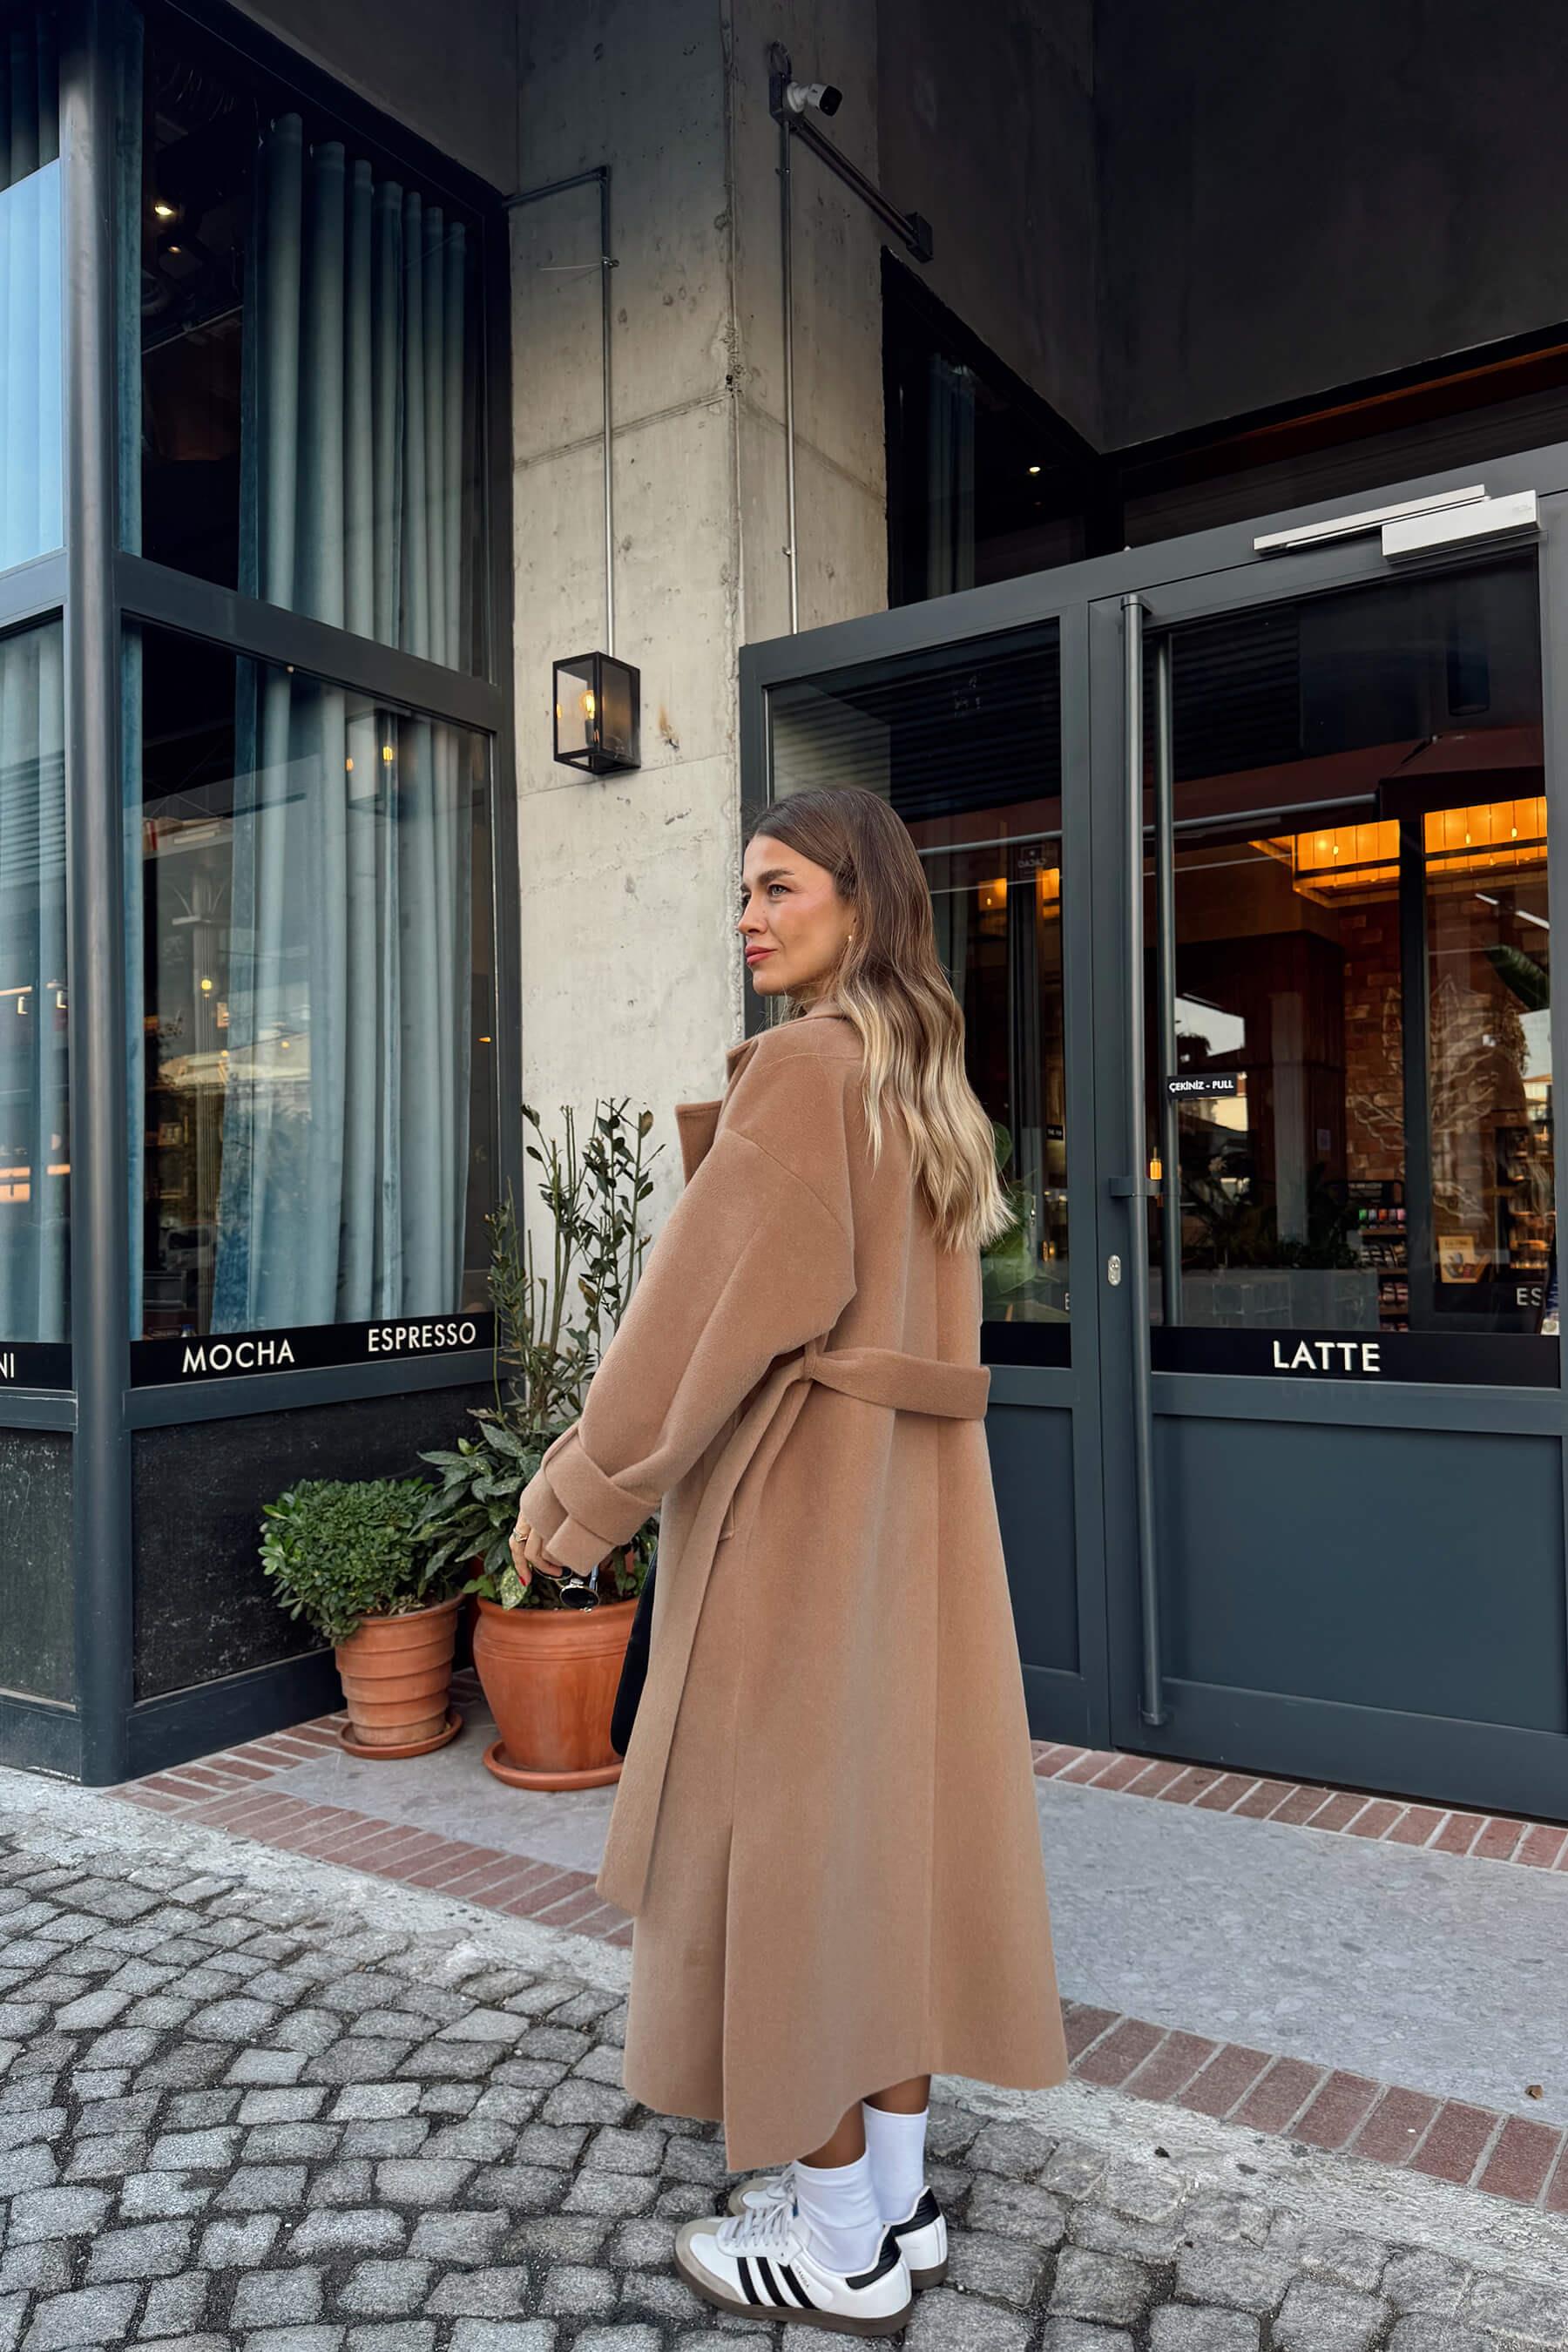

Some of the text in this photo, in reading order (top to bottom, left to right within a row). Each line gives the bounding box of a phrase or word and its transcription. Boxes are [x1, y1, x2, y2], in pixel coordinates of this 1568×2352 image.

[1212, 1079, 1234, 1090] PULL
[367, 1321, 476, 1353] ESPRESSO
[181, 1338, 295, 1374] MOCHA
[1273, 1340, 1381, 1373] LATTE
